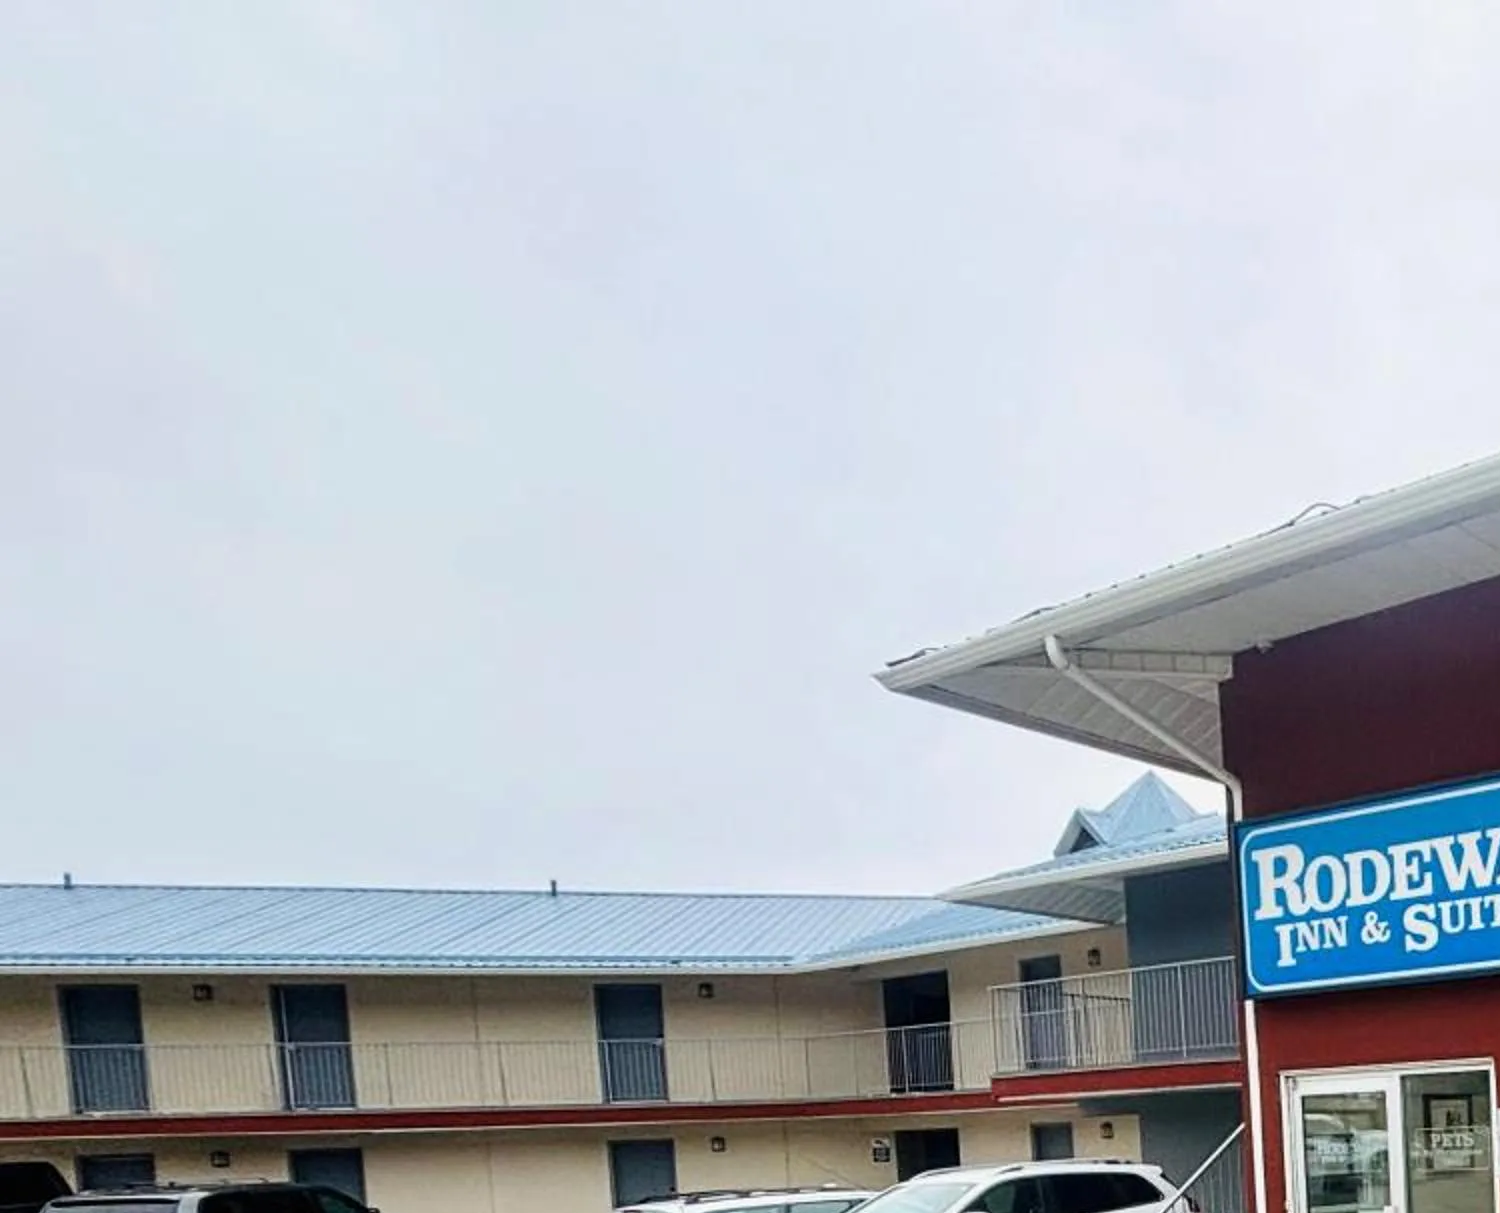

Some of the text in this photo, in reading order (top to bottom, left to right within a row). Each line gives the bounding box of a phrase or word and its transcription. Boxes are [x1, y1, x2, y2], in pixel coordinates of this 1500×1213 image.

[1275, 916, 1348, 967] INN
[1360, 911, 1391, 945] &
[1430, 1133, 1475, 1148] PETS
